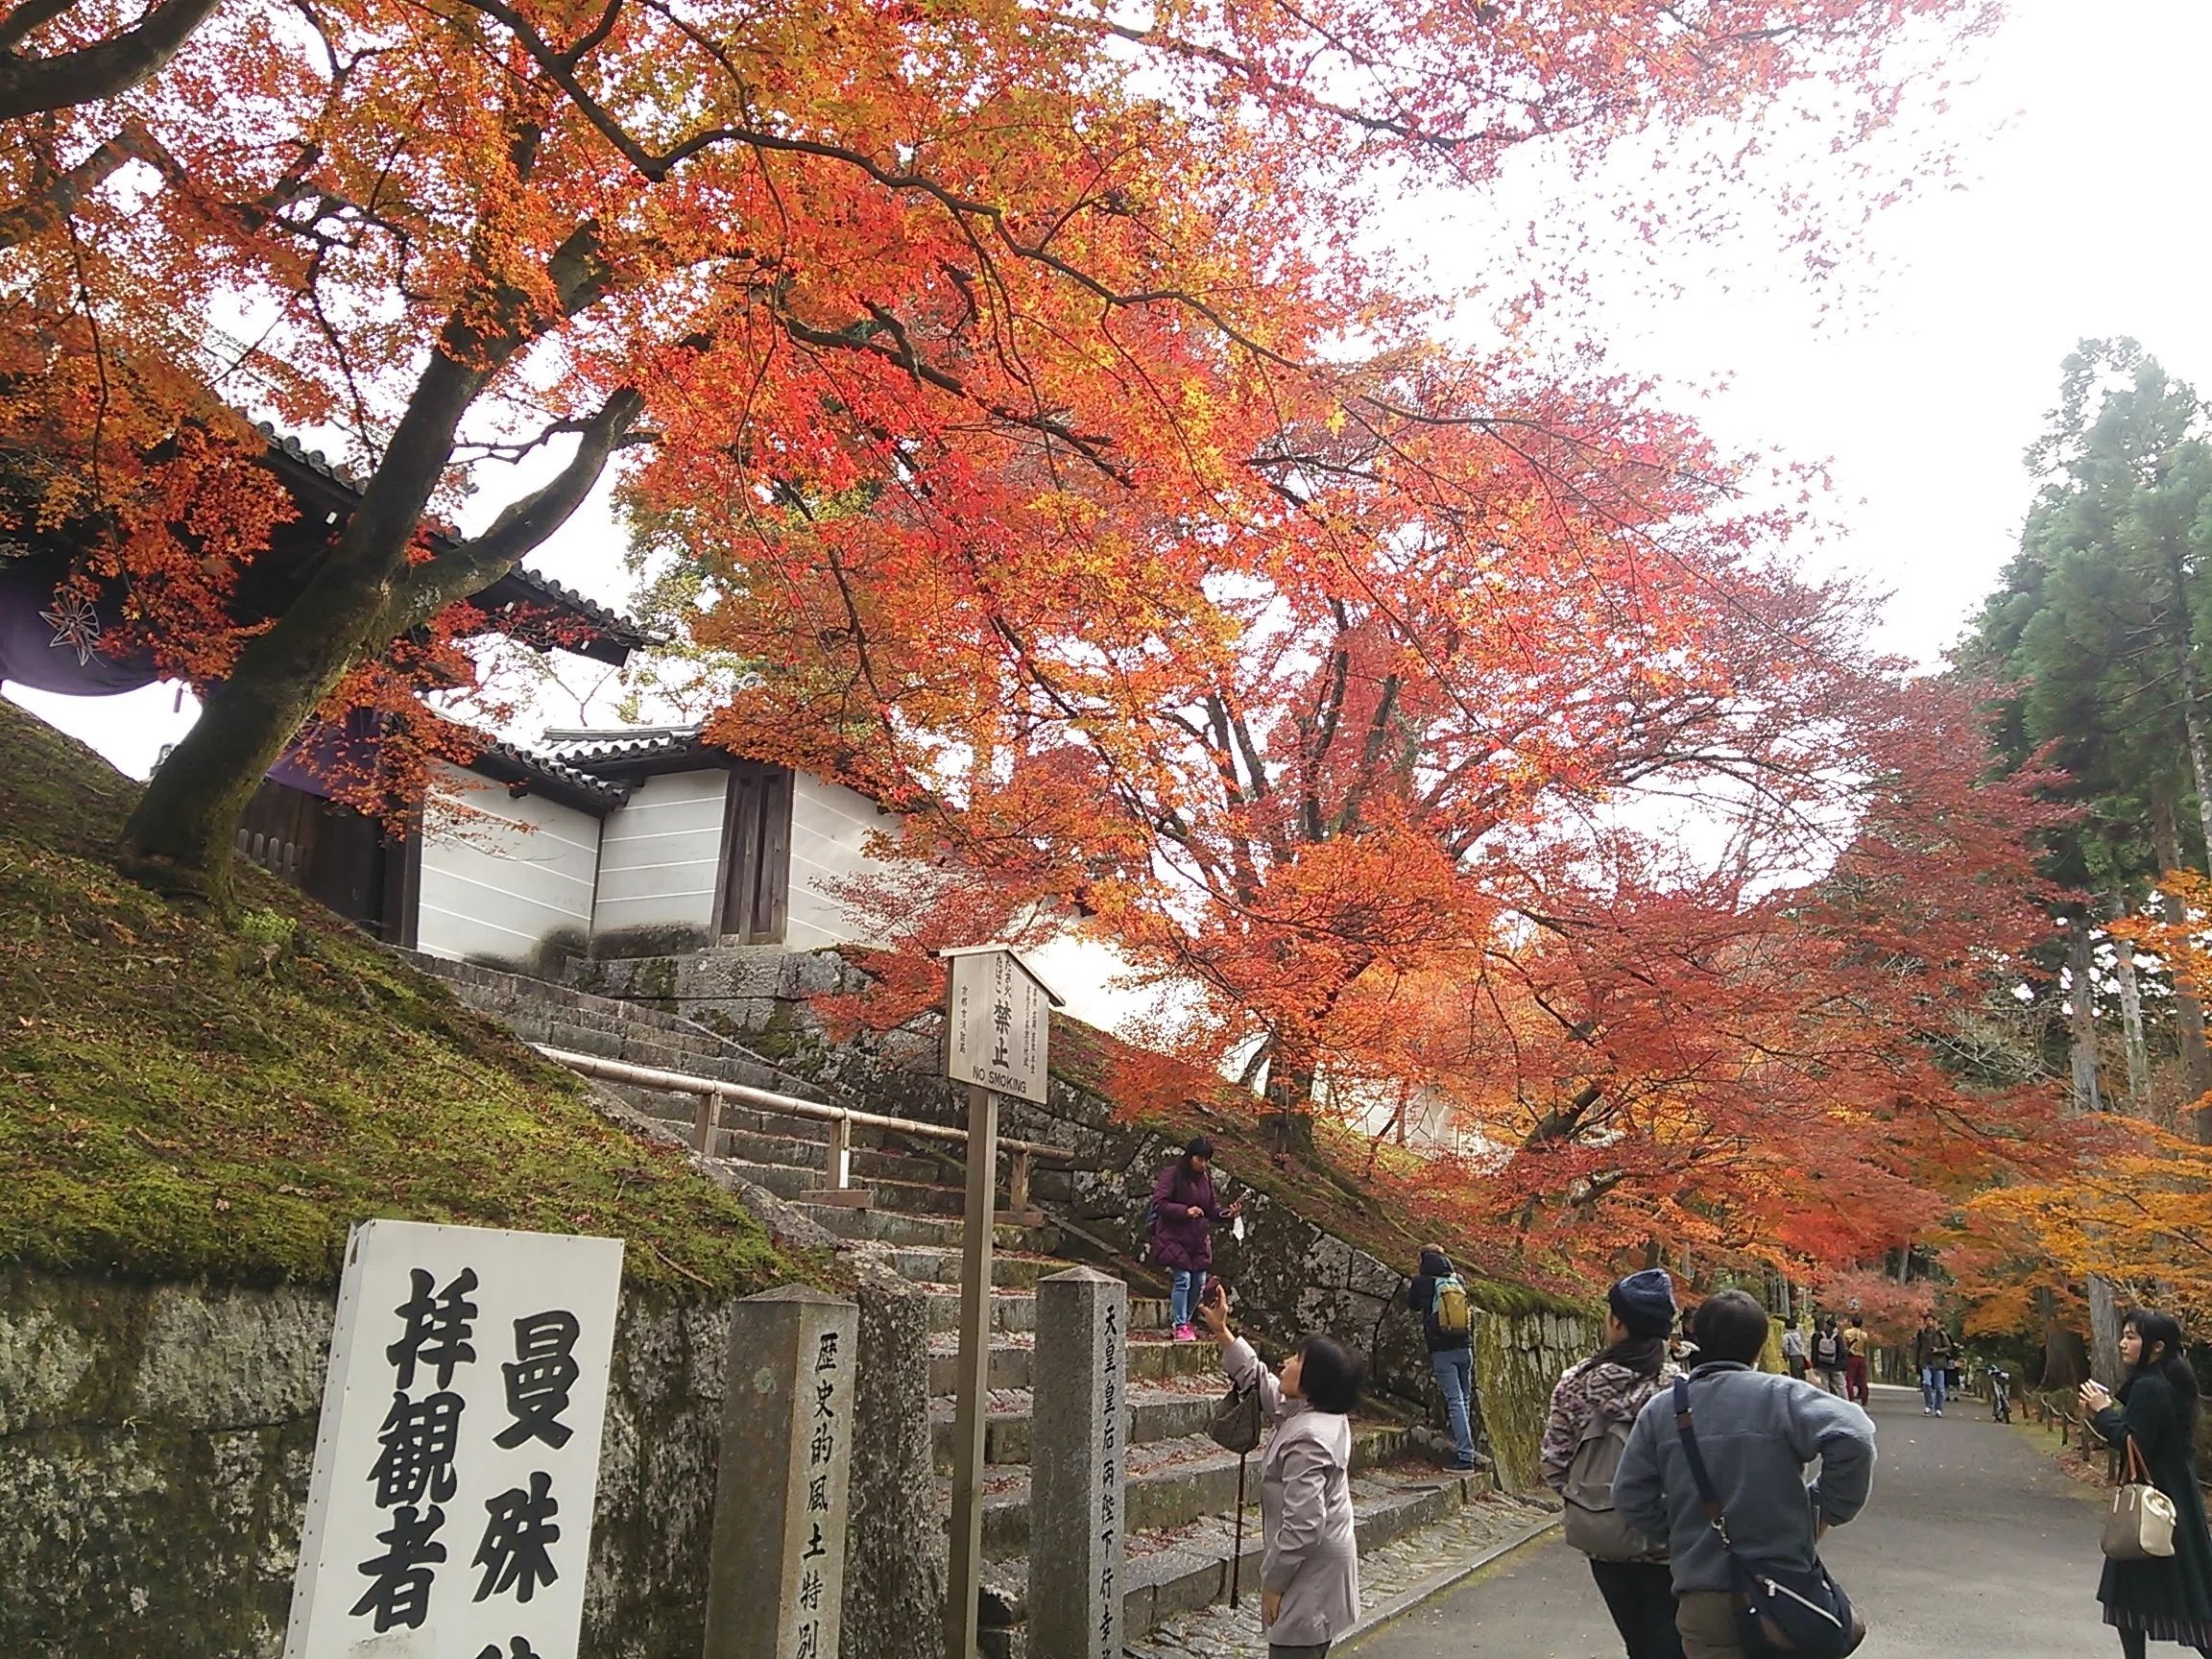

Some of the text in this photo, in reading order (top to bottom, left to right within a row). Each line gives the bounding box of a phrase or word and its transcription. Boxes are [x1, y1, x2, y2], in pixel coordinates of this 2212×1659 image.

[973, 1065, 1027, 1094] NO SMOKING
[992, 998, 1013, 1070] 禁止
[349, 1266, 479, 1633] 拝観者
[470, 1310, 582, 1659] 曼殊
[1099, 1304, 1118, 1659] 天皇皇后両陛下行幸
